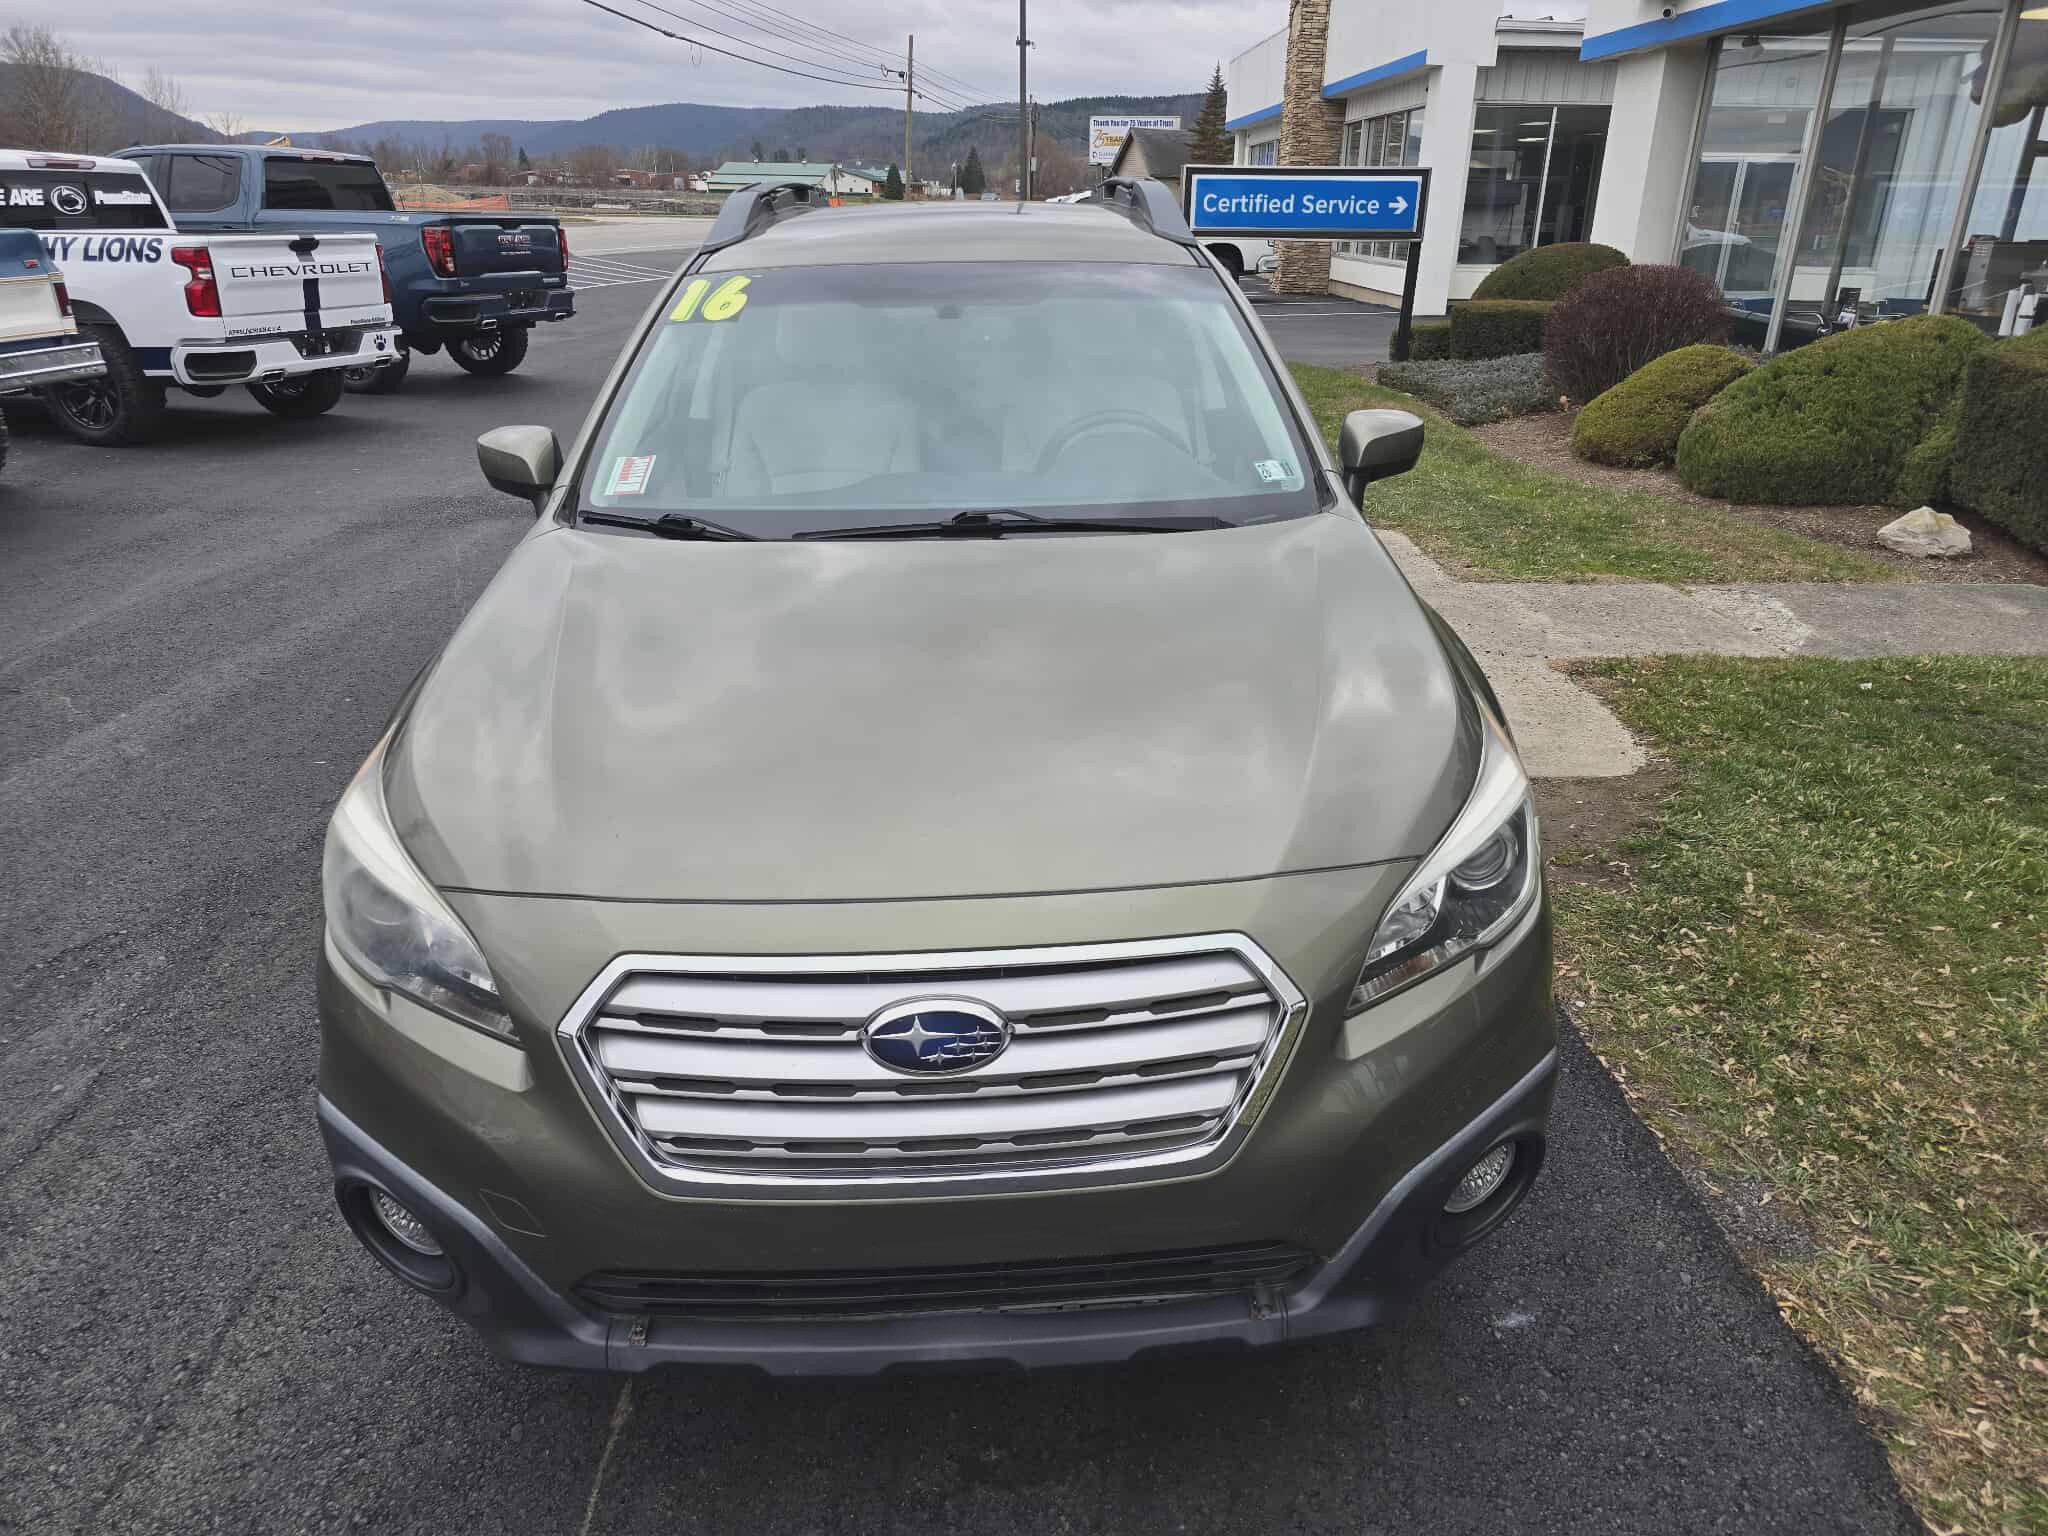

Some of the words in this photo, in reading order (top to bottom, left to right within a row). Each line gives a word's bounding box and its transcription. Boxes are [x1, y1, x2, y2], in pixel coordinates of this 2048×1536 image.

[1094, 119, 1109, 127] Thank
[1130, 119, 1136, 127] 75
[1137, 119, 1152, 127] Years
[9, 188, 45, 206] ARE
[1202, 193, 1294, 213] Certified
[1301, 195, 1380, 214] Service
[82, 237, 163, 263] LIONS
[231, 262, 372, 278] CHEVROLET
[670, 275, 752, 321] 16
